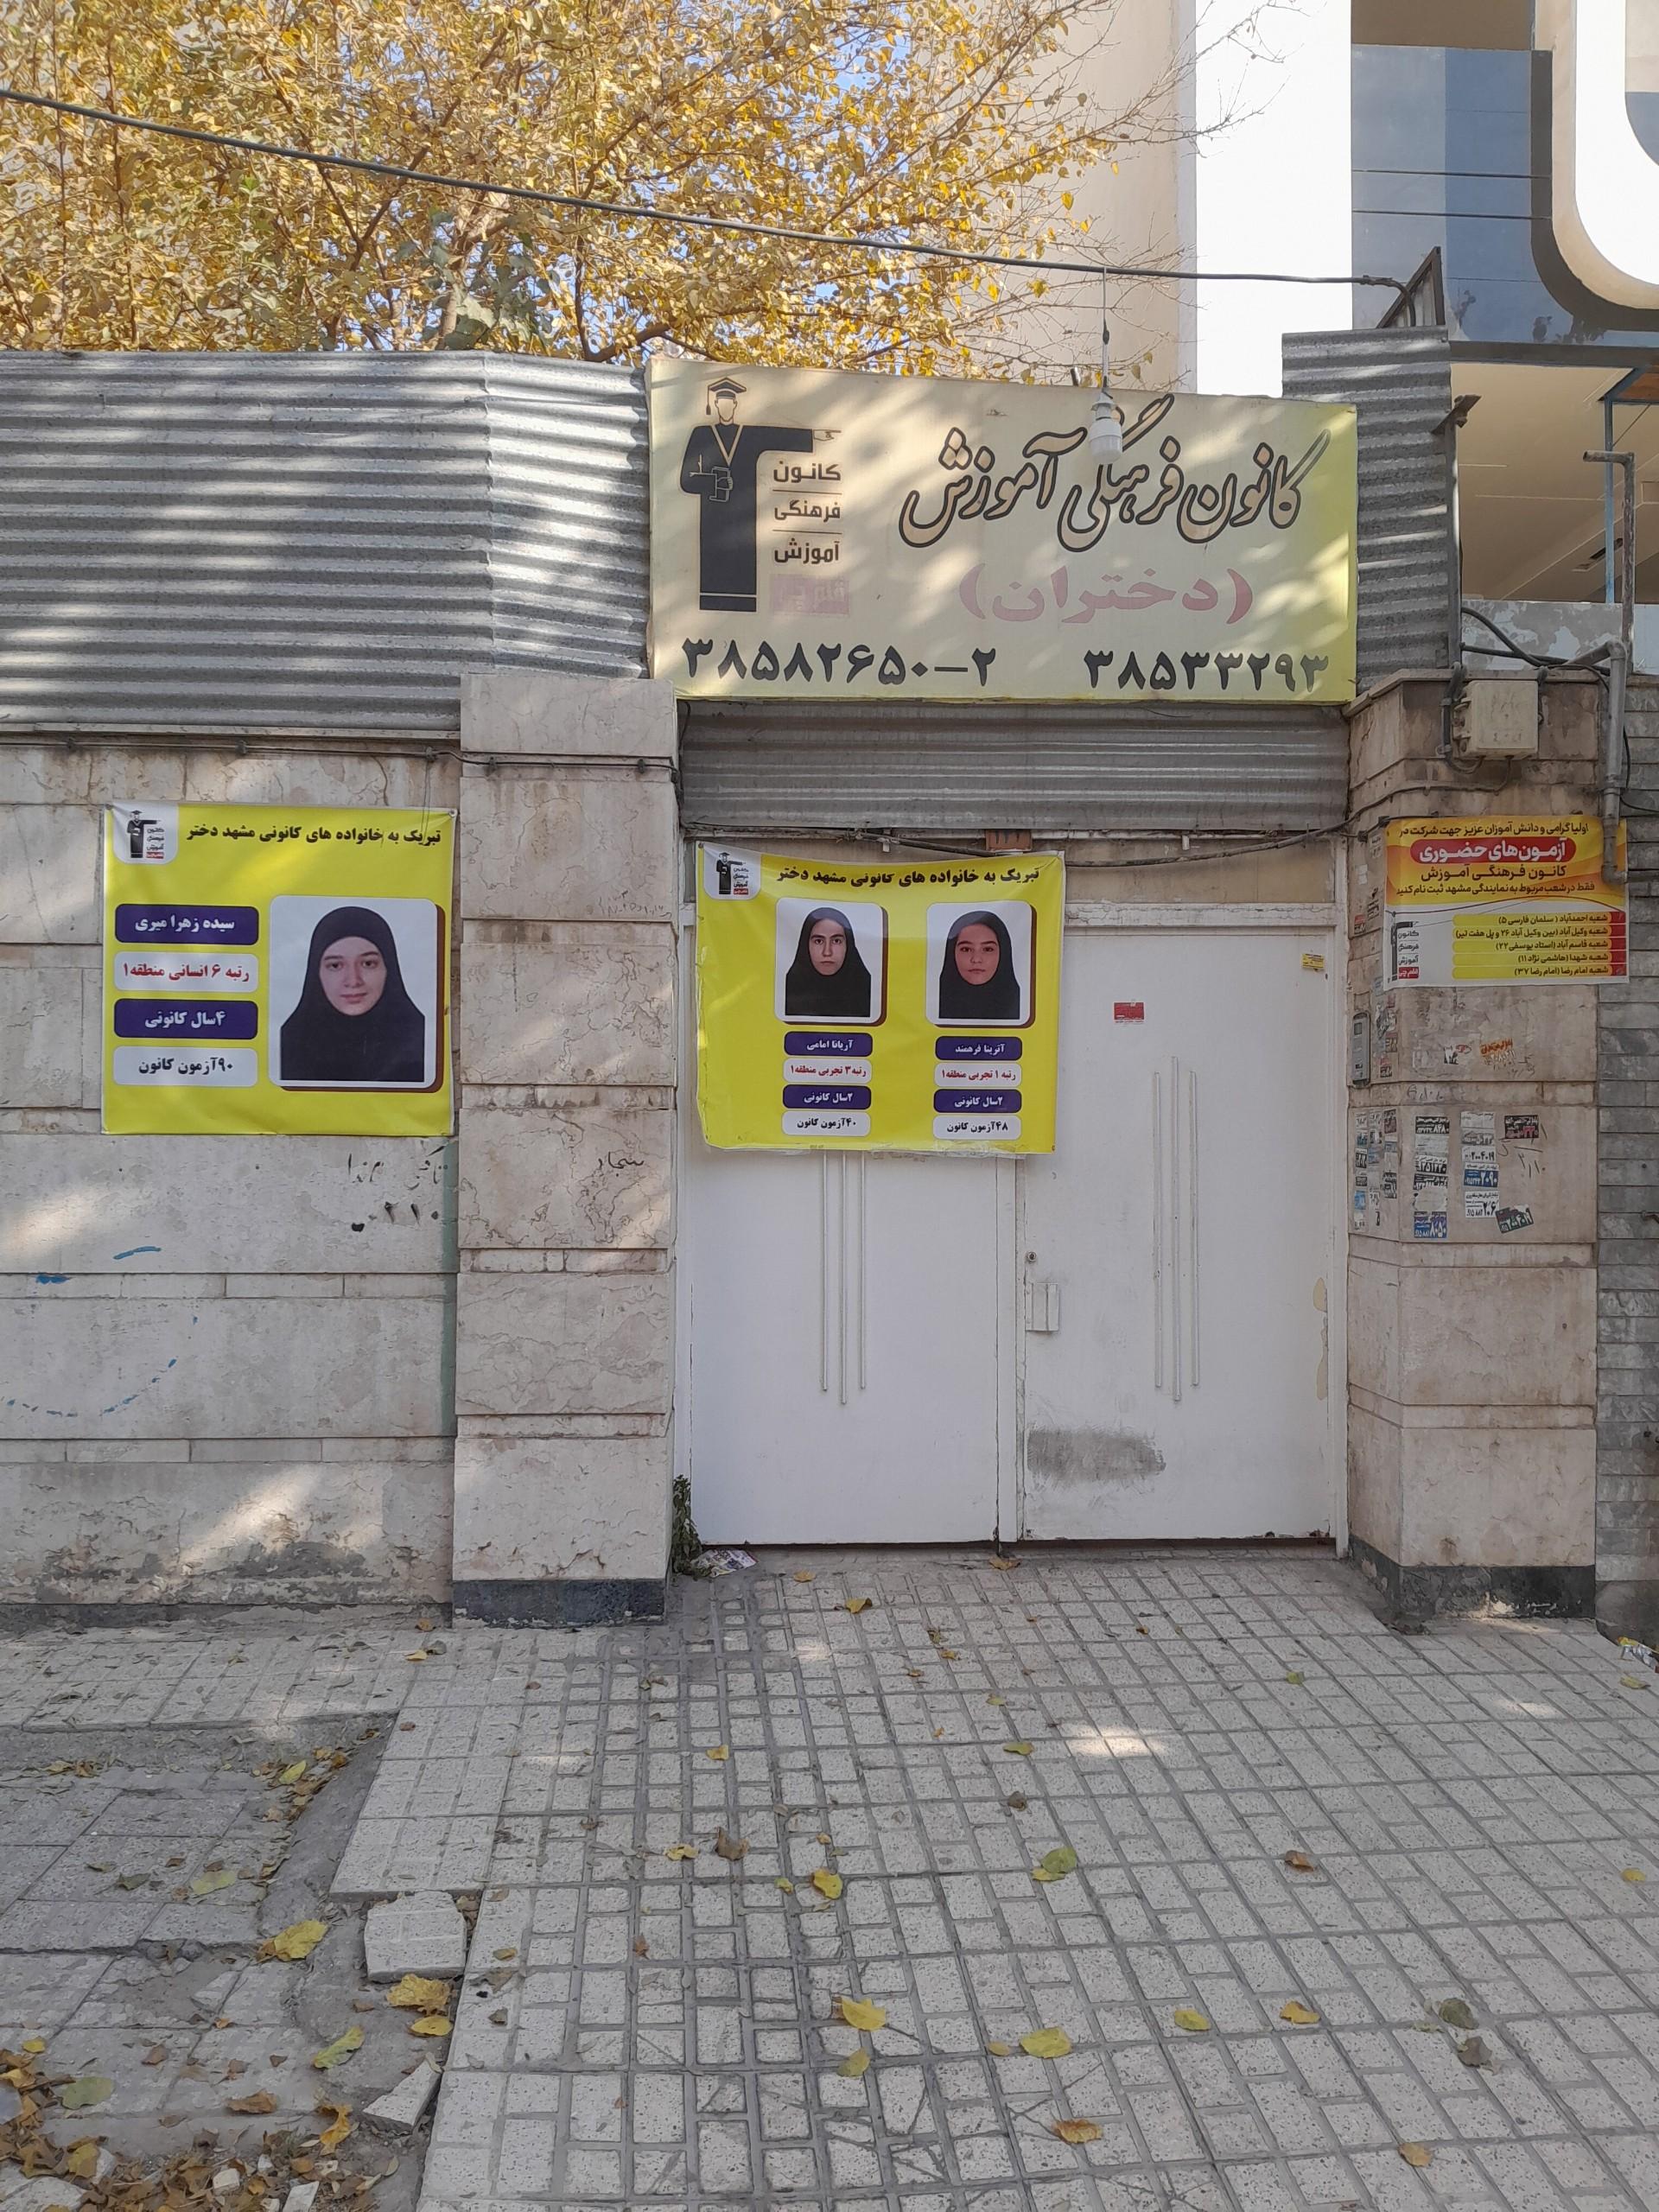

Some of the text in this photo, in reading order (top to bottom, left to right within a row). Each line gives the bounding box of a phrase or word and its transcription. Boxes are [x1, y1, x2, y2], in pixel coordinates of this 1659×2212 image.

[772, 461, 842, 484] کانون
[899, 427, 1088, 548] آموزش
[1177, 429, 1331, 543] کانون
[774, 499, 841, 523] فرهنگی
[773, 537, 840, 564] آموزش
[1084, 650, 1329, 693] ۳۸۵۳۳۲۹۳
[1400, 829, 1409, 837] در
[1410, 826, 1439, 837] شرکت
[1440, 827, 1462, 836] جهت
[1464, 826, 1483, 836] عزیز
[1546, 822, 1571, 835] گرامی
[187, 823, 441, 846] تبریک به خانواده های کانونی مشهد دختر
[1420, 842, 1487, 863] حضوری
[777, 866, 1039, 888] تبریک به خانواده های کانونی مشهد دختر
[1421, 863, 1567, 881] کانون فرهنگی آموزش
[1445, 883, 1471, 895] مشهد
[1471, 883, 1509, 895] نمایندگی
[1519, 881, 1544, 894] مربوط
[1544, 883, 1567, 894] شعب
[1567, 885, 1575, 893] در
[1577, 882, 1595, 892] فقط
[135, 914, 235, 932] سیده زهرا میری
[1508, 915, 1529, 925] فارسی
[1589, 914, 1608, 924] شعبه
[1398, 930, 1420, 939] کانون
[1523, 929, 1541, 938] وکیل
[1571, 927, 1587, 937] وکیل
[1589, 927, 1608, 937] شعبه
[1509, 942, 1534, 951] یوسفی
[1568, 939, 1587, 950] قاسم
[1589, 940, 1608, 950] شعبه
[1398, 954, 1419, 965] آموزش
[1528, 954, 1540, 964] نژاد
[1569, 954, 1587, 963] شهدا
[1589, 953, 1609, 963] شعبه
[168, 964, 208, 981] انسانی
[225, 965, 250, 982] رتبه
[1530, 967, 1543, 977] رضا
[1560, 967, 1573, 976] رضا
[1573, 967, 1588, 976] امام
[1589, 966, 1609, 976] شعبه
[144, 1011, 188, 1028] کانونی
[806, 1039, 854, 1052] آریانا امامی
[138, 1058, 175, 1074] کانون
[818, 1065, 843, 1077] تجربی
[969, 1070, 994, 1081] تجربی
[1001, 1070, 1016, 1081] رتبه
[804, 1091, 830, 1103] کانونی
[954, 1096, 981, 1108] کانونی
[797, 1117, 819, 1128] کانون
[946, 1122, 969, 1133] کانون
